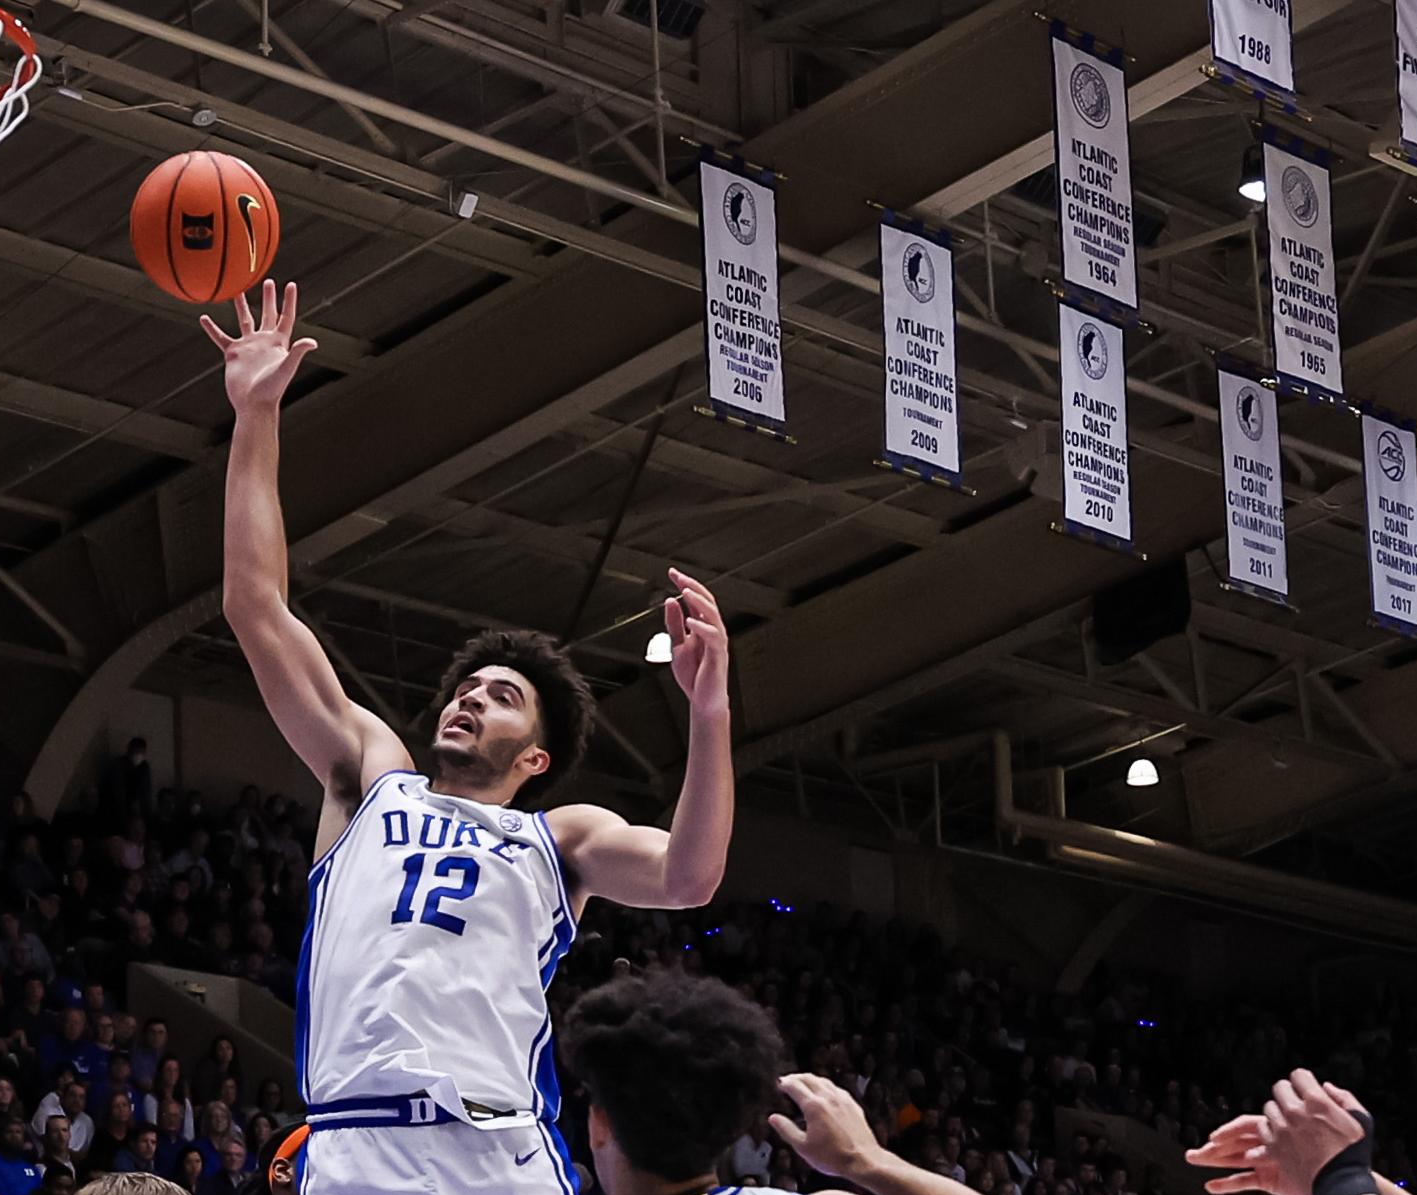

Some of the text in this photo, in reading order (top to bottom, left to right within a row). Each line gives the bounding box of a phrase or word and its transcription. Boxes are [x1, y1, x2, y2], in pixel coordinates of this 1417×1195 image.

[1238, 34, 1271, 65] 1988
[1071, 138, 1118, 174] ATLANTIC
[1079, 164, 1112, 192] COAST
[1063, 178, 1131, 224] CONFERENCE
[1067, 202, 1130, 246] CHAMPIONS
[1281, 237, 1324, 269] ATLANTIC
[718, 259, 767, 293] ATLANTIC
[1088, 259, 1117, 287] 1964
[1290, 261, 1319, 287] COAST
[726, 284, 761, 311] COAST
[1274, 276, 1336, 314] CONFERENCE
[710, 299, 780, 340] CONFERENCE
[1279, 298, 1336, 334] CHAMPIONS
[714, 322, 779, 361] CHAMPIONS
[896, 317, 945, 347] ATLANTIC
[906, 340, 939, 366] COAST
[1300, 351, 1326, 375] 1965
[887, 355, 954, 394] CONFERENCE
[733, 377, 763, 403] 2006
[890, 378, 953, 414] CHAMPIONS
[1073, 391, 1117, 422] ATLANTIC
[911, 429, 938, 454] 2009
[1082, 414, 1111, 439] COAST
[1065, 429, 1127, 465] CONFERENCE
[1068, 450, 1125, 484] CHAMPIONS
[1234, 454, 1273, 481] ATLANTIC
[1241, 476, 1267, 498] COAST
[1085, 500, 1113, 522] 2010
[1228, 490, 1284, 522] CONFERENCE
[1379, 495, 1414, 521] ATLANTIC
[1232, 511, 1283, 541] CHAMPIONS
[1384, 516, 1409, 537] COAST
[1250, 557, 1273, 579] 2011
[1391, 595, 1412, 614] 2017
[381, 809, 535, 865] DUKE
[390, 851, 481, 937] 12
